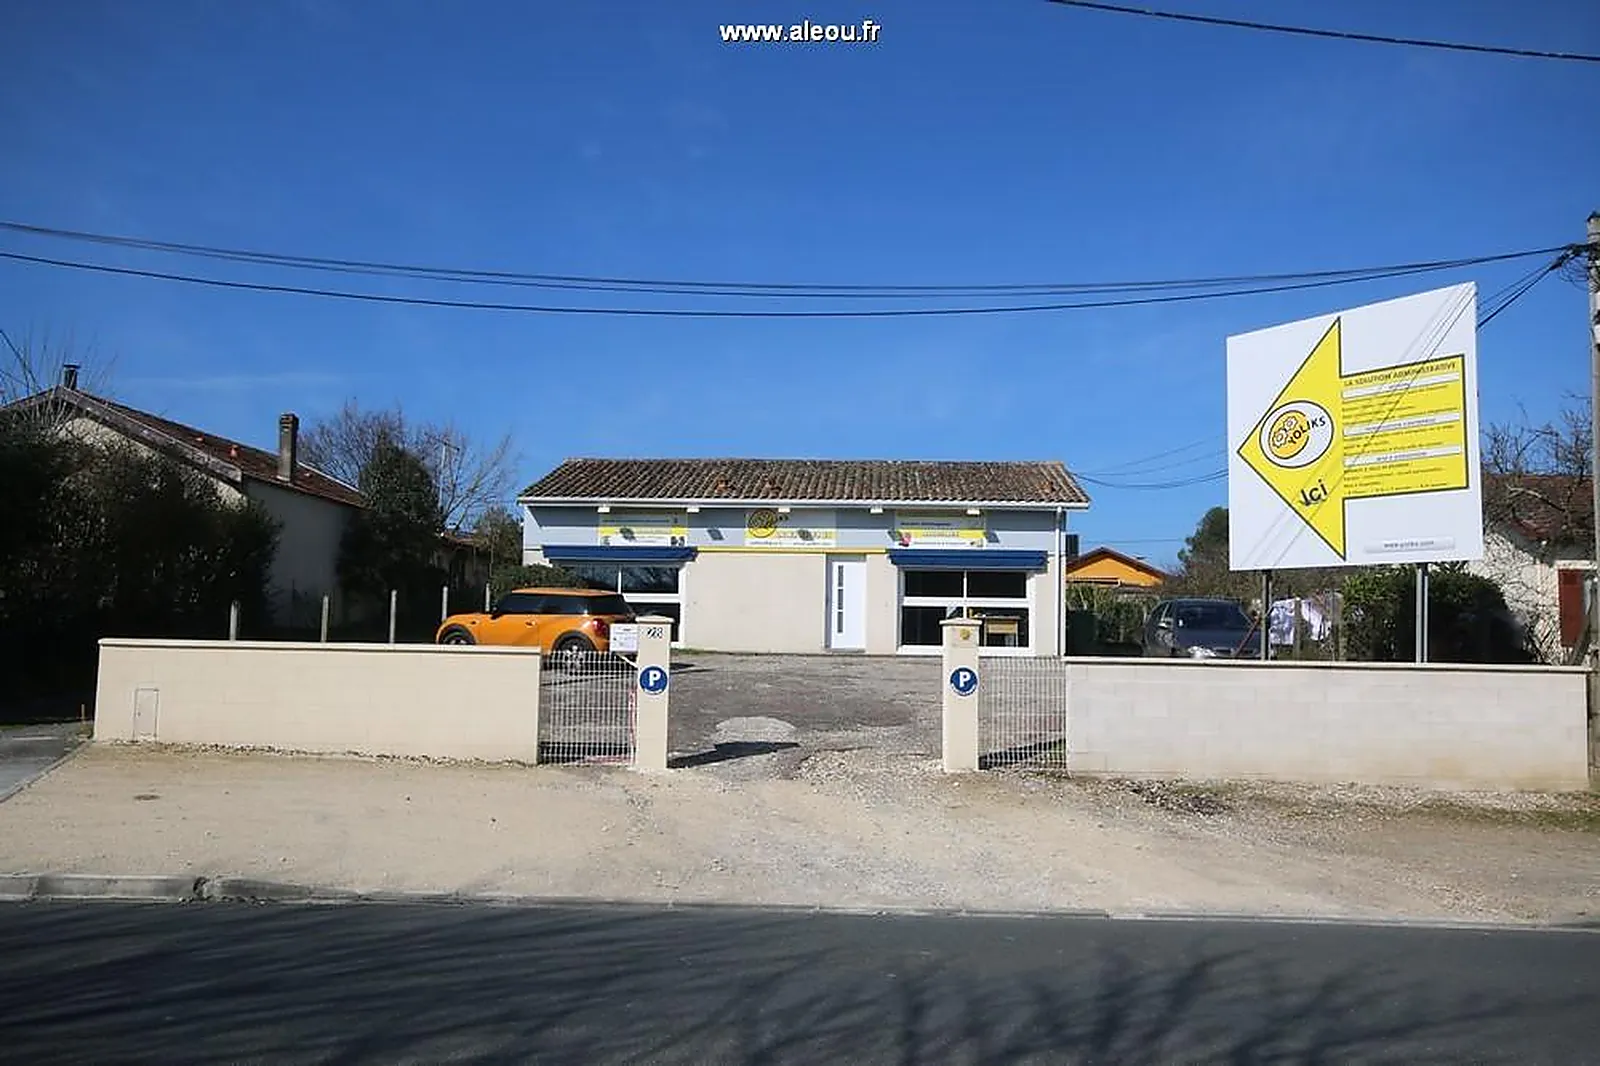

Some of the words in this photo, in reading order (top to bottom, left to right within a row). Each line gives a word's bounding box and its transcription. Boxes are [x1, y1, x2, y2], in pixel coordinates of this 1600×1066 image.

[1288, 415, 1326, 444] YOLIKS
[649, 670, 661, 687] P
[960, 671, 971, 688] P
